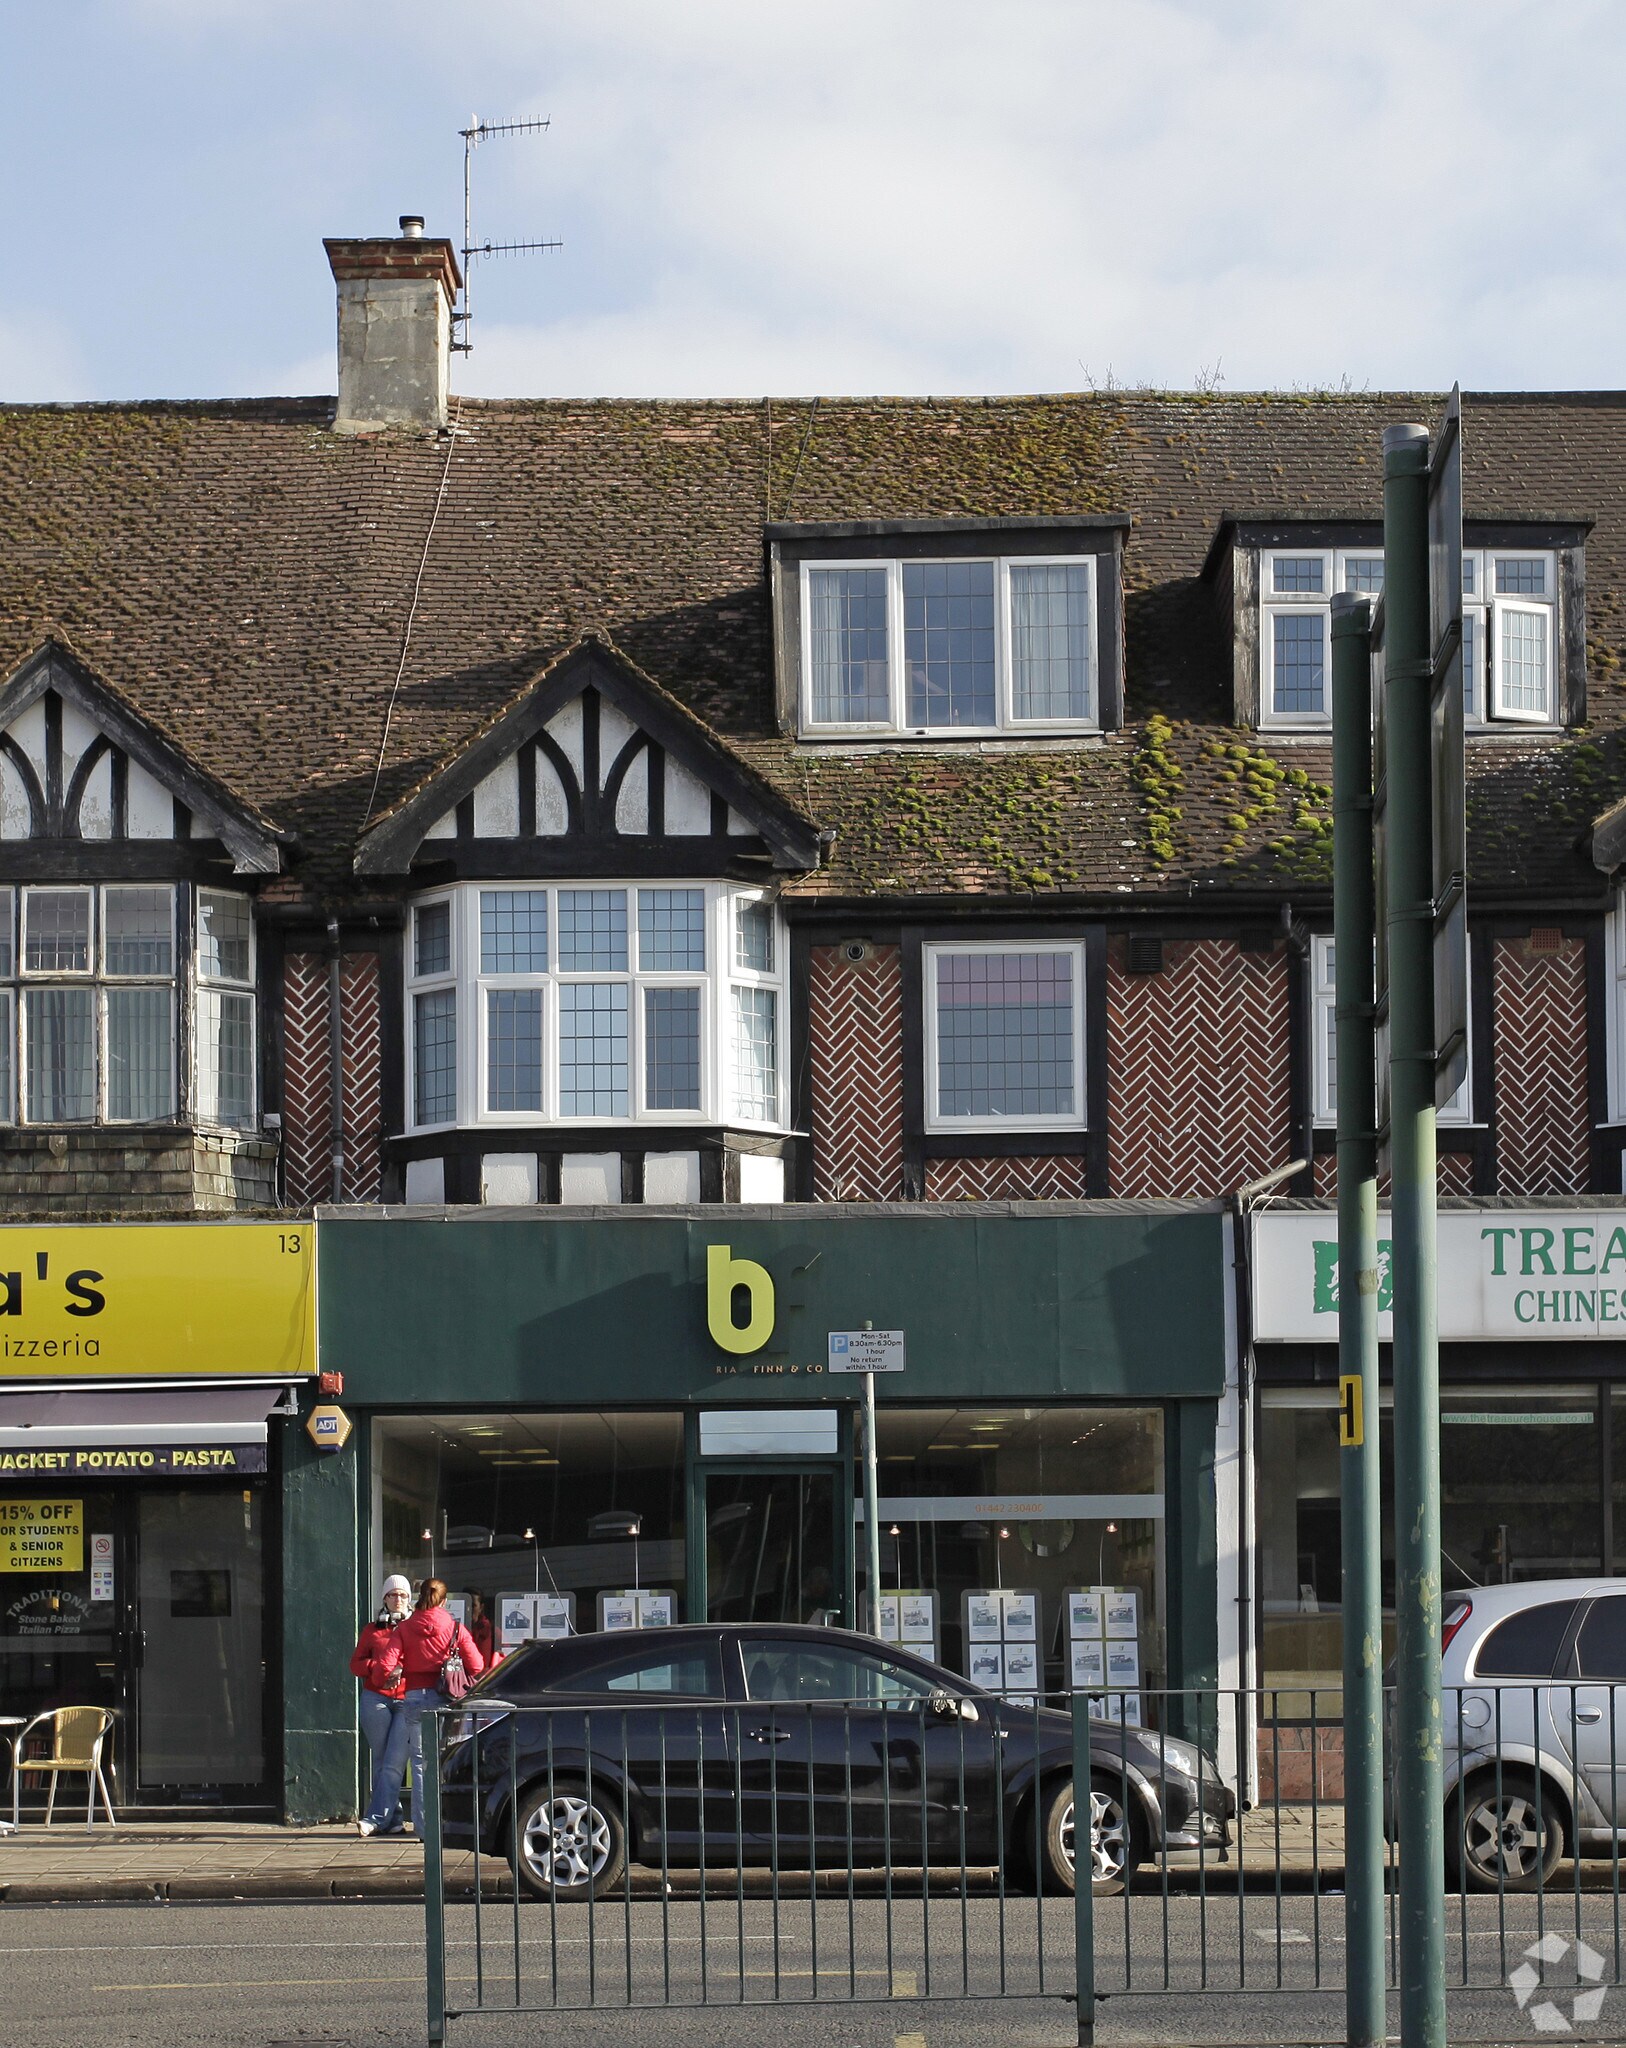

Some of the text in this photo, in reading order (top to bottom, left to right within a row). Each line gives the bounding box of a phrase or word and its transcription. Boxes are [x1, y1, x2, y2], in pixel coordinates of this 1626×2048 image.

[278, 1234, 301, 1254] 13
[753, 1365, 783, 1374] FINN
[790, 1364, 799, 1373] &
[806, 1364, 823, 1373] CO
[316, 1420, 336, 1430] ADT
[76, 1451, 154, 1467] POTATO
[172, 1450, 236, 1466] PASTA
[0, 1505, 74, 1520] 15% OFF
[19, 1525, 80, 1536] STUDENTS
[9, 1541, 64, 1551] & SENIOR
[10, 1556, 64, 1567] CITIZENS
[6, 1589, 94, 1619] TRADITIONAL
[18, 1614, 81, 1624] Stone Baked
[18, 1625, 81, 1634] Italian Pizza
